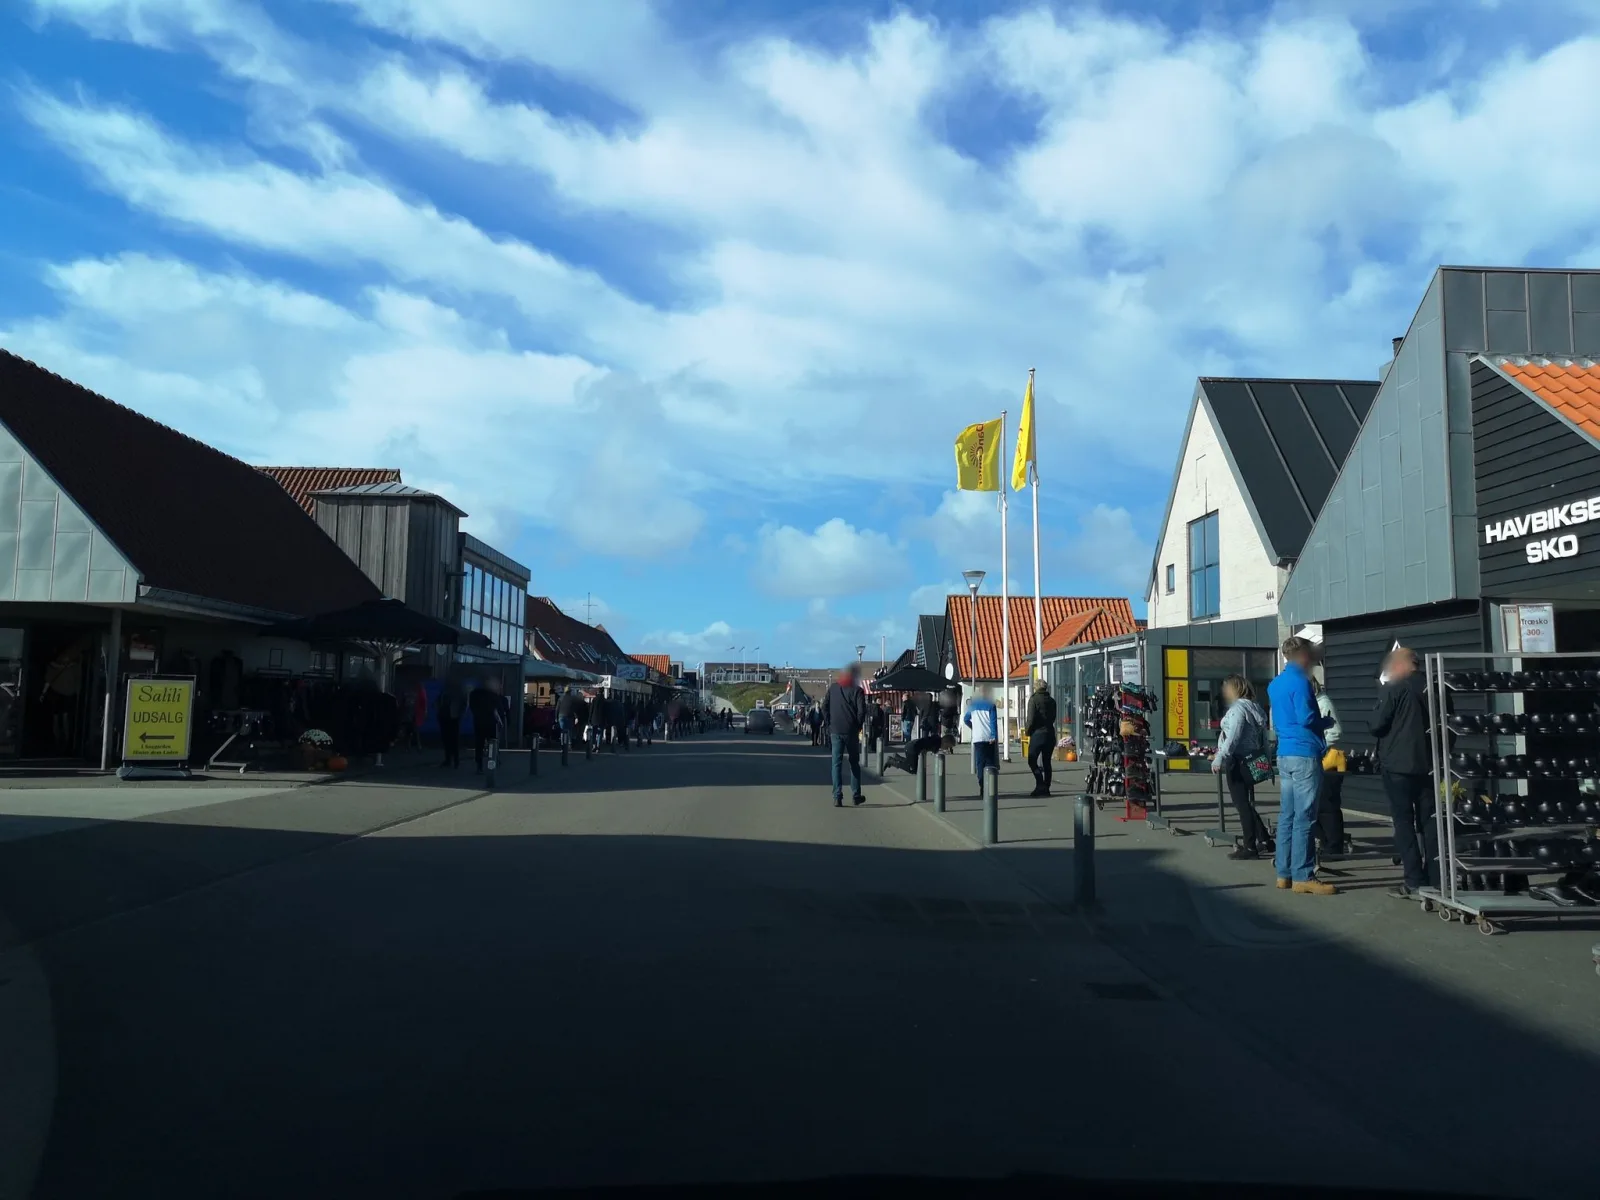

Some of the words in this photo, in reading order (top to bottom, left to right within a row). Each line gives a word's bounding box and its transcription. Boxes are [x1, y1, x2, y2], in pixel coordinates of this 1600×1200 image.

[1525, 534, 1579, 564] SKO
[138, 685, 182, 702] Salili
[133, 711, 183, 723] UDSALG
[1175, 683, 1184, 736] DanCenter
